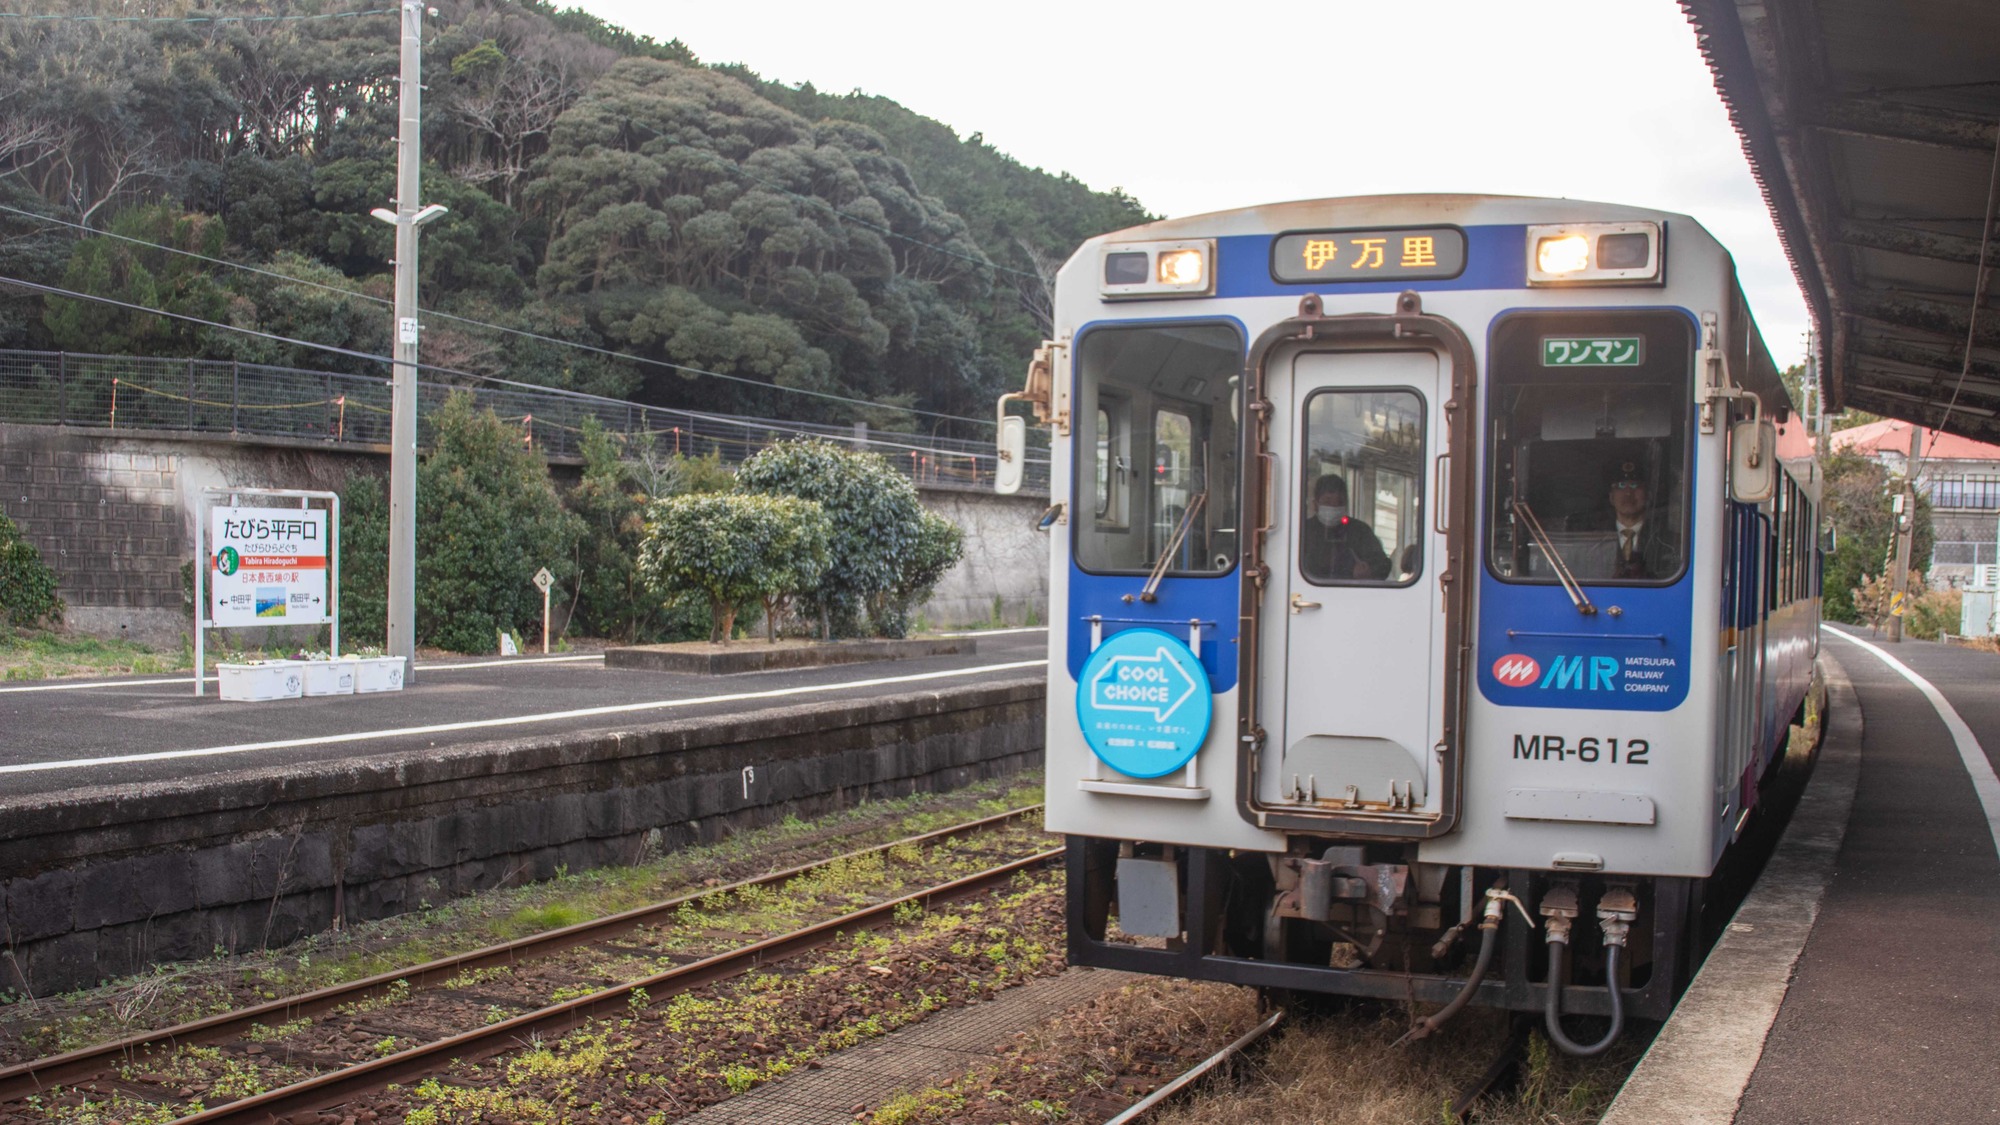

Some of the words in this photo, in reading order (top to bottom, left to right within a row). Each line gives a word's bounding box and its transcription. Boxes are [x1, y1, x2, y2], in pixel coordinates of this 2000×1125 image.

[1302, 236, 1437, 271] 伊万里
[1548, 341, 1635, 363] ワンマン
[224, 518, 317, 541] たびら平戸口
[244, 543, 298, 553] たびらひらどぐち
[245, 557, 262, 566] Tabira
[263, 557, 298, 567] Hiradoguchi
[540, 573, 548, 586] 3
[1625, 657, 1676, 667] MATSUURA
[1118, 665, 1169, 683] COOL
[1539, 655, 1620, 691] MR
[1625, 670, 1664, 680] RAILWAY
[1104, 684, 1169, 703] CHOICE
[1624, 683, 1670, 693] COMPANY
[1513, 734, 1650, 765] MR-612
